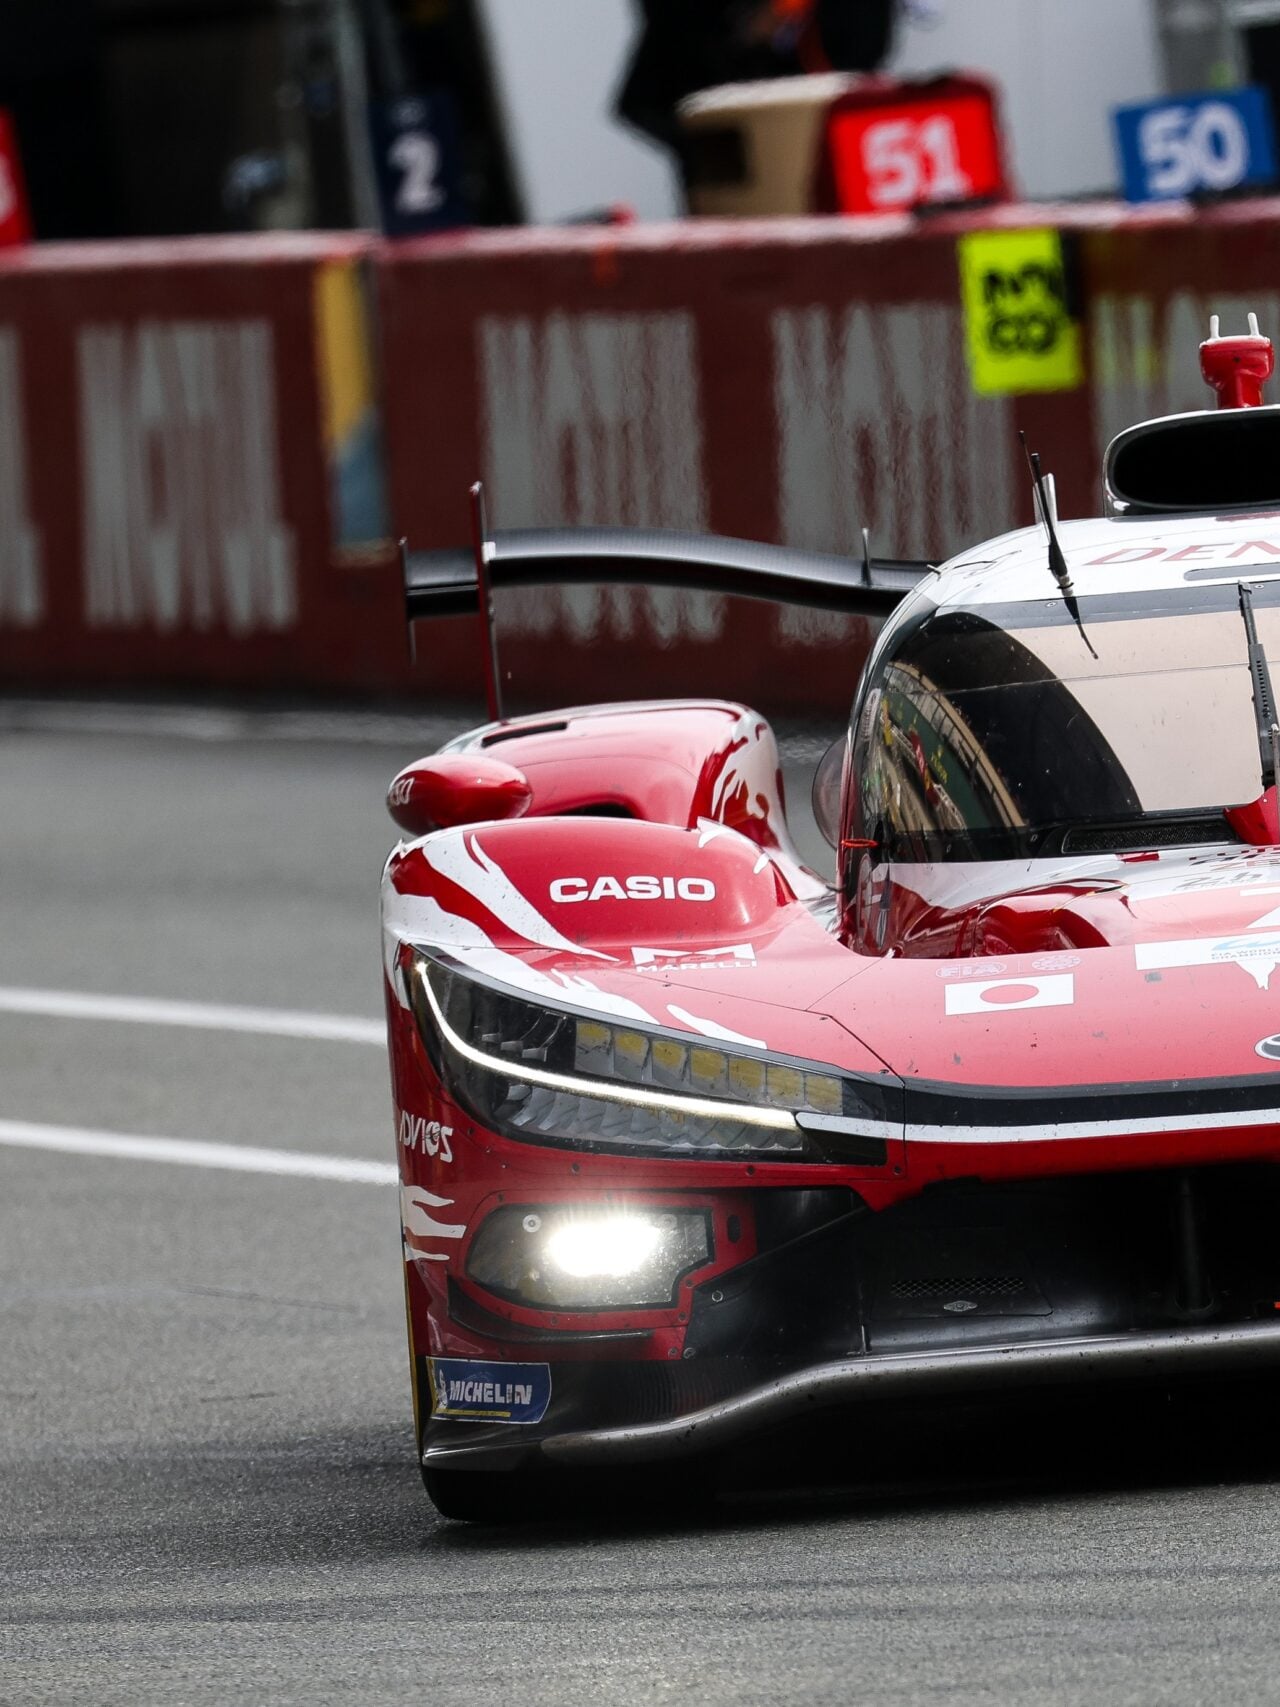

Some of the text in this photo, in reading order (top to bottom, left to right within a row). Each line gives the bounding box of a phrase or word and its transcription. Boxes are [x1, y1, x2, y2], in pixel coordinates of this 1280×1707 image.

[861, 114, 972, 206] 51
[1138, 102, 1248, 194] 50
[549, 876, 716, 903] CASIO
[635, 960, 758, 974] MARELLI
[449, 1380, 533, 1405] MICHELIN
